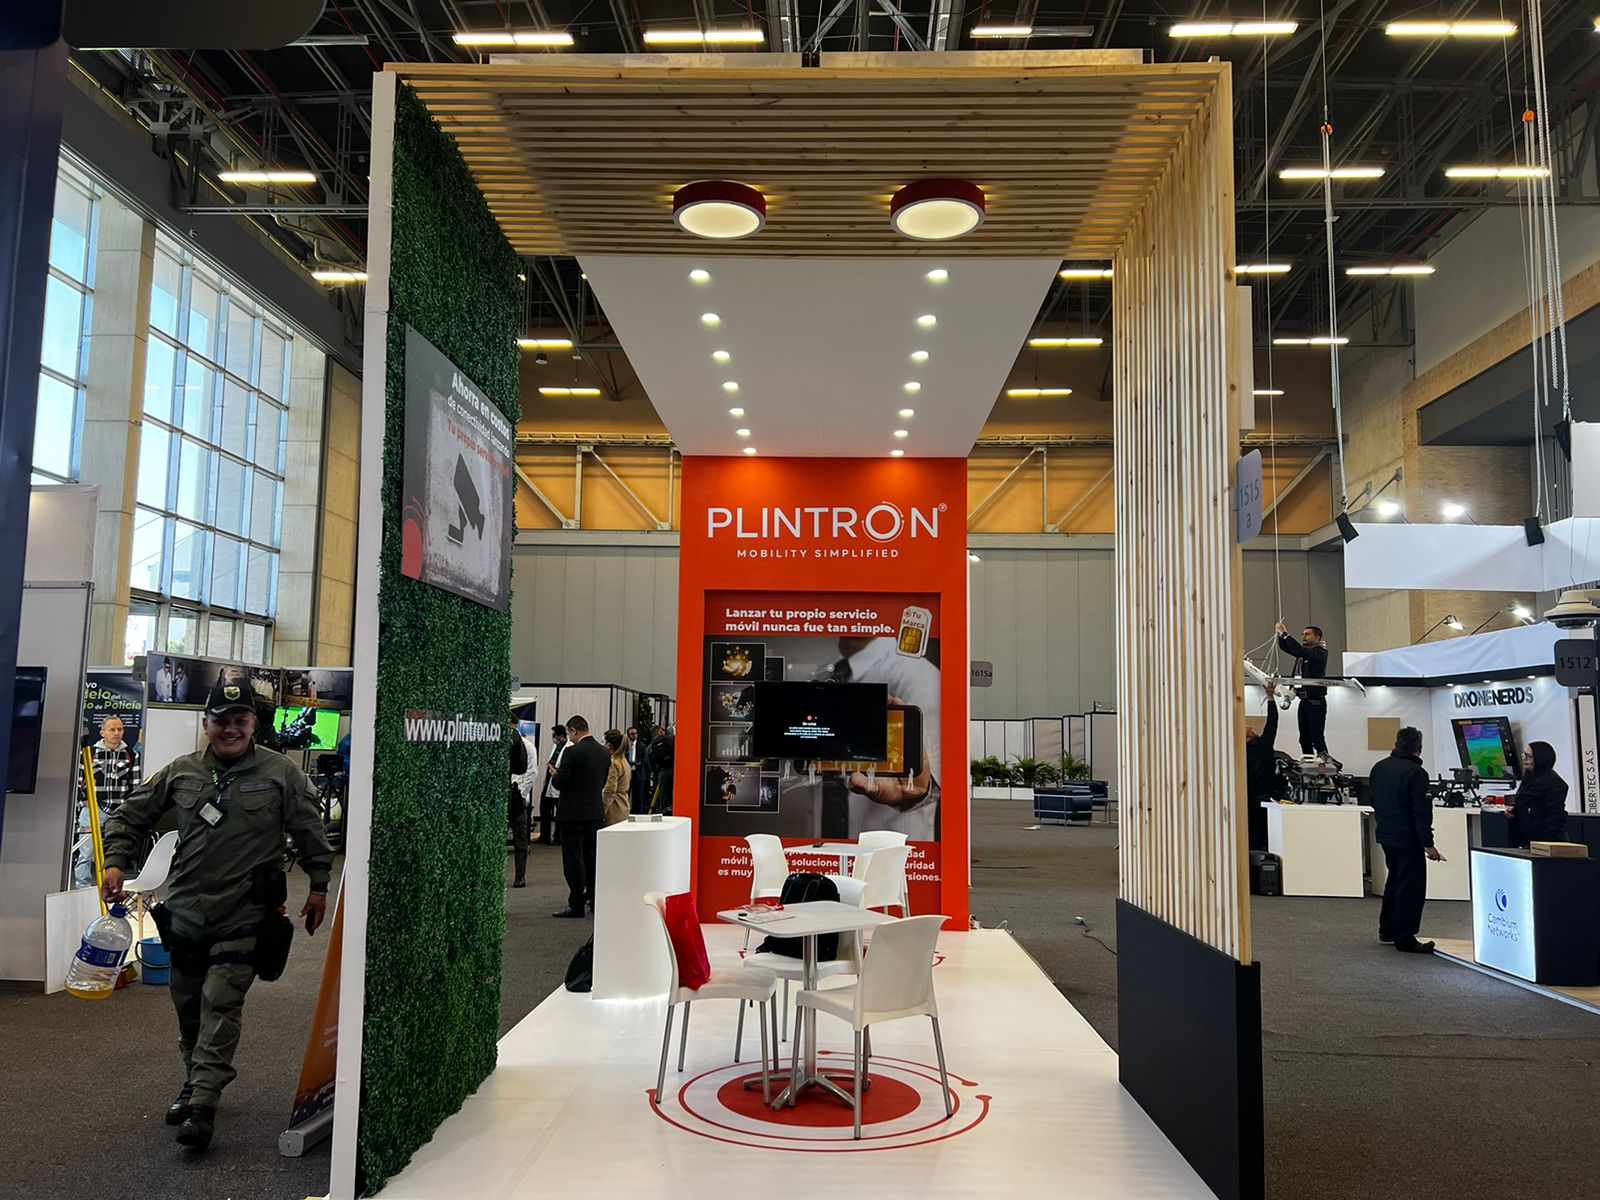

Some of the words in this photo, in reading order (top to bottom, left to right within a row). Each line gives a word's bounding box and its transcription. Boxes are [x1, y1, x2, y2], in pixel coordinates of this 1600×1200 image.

[447, 394, 456, 410] de
[452, 372, 479, 410] Ahorra
[480, 402, 489, 420] en
[490, 412, 510, 440] costos
[1240, 479, 1260, 508] 1515
[737, 549, 808, 558] MOBILITY
[814, 549, 899, 558] SIMPLIFIED
[725, 608, 766, 618] Lanzar
[769, 609, 783, 618] tu
[786, 609, 826, 621] propio
[829, 609, 878, 620] servicio
[725, 621, 760, 632] móvil
[762, 623, 800, 632] nunca
[803, 622, 824, 632] fue
[826, 623, 848, 633] tan
[850, 623, 895, 635] simple.
[1560, 657, 1591, 669] 1512
[1453, 686, 1534, 708] DRONENERDS
[104, 700, 142, 710] Policía
[404, 713, 501, 749] www.plintron.co
[791, 858, 840, 866] solucione
[731, 869, 752, 878] muy
